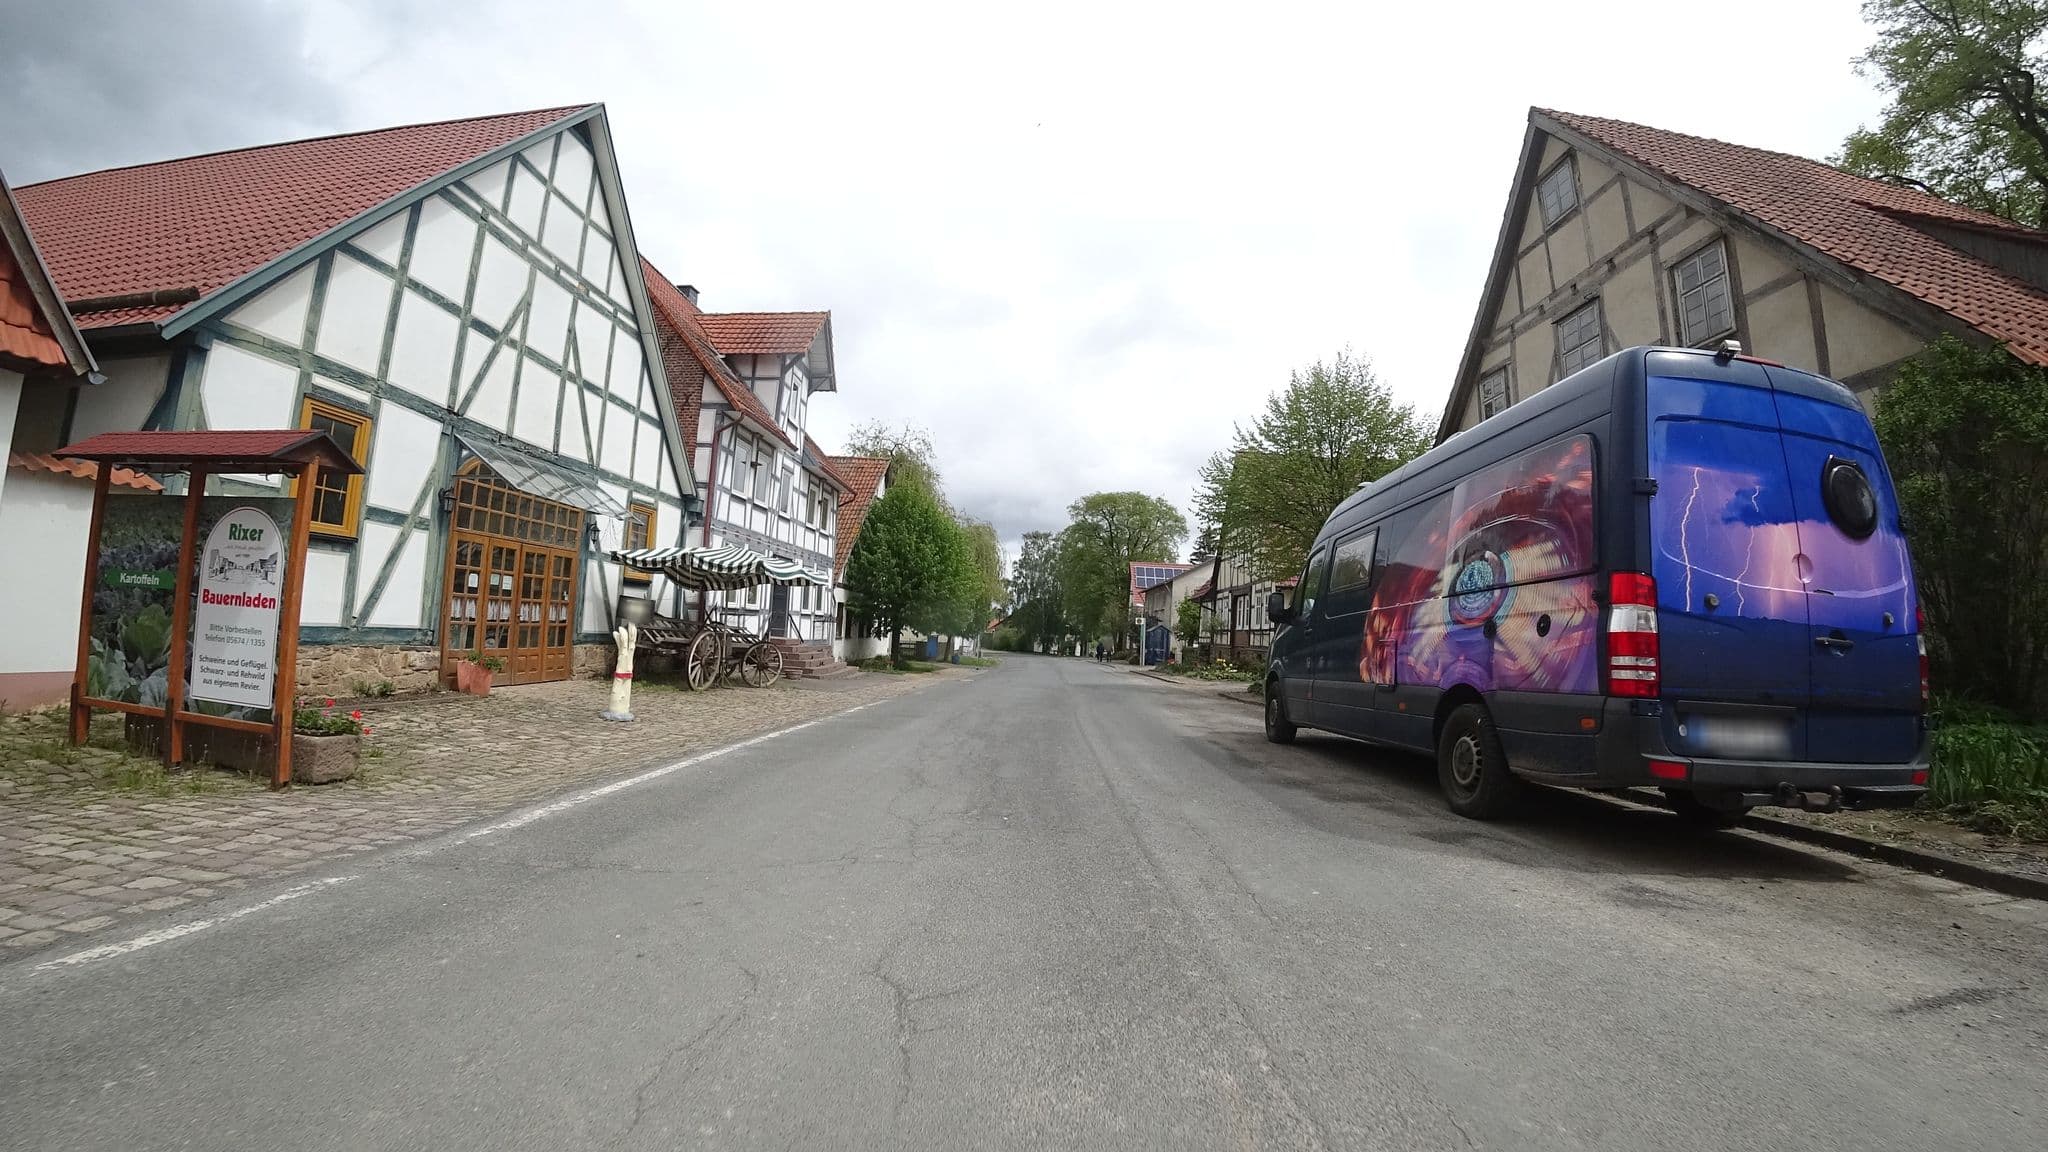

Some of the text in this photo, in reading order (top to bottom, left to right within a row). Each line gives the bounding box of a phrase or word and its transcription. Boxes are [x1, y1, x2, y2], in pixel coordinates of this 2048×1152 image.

[229, 523, 264, 542] Rixer
[120, 573, 160, 585] Kartoffeln
[202, 588, 276, 610] Bauernladen
[210, 624, 262, 636] Bitte Vorbestellen
[205, 633, 225, 643] Telefon
[251, 638, 266, 647] 1355
[199, 654, 226, 665] Schweine
[227, 670, 239, 678] und
[240, 670, 266, 681] Rehwild
[213, 679, 239, 688] eigenem
